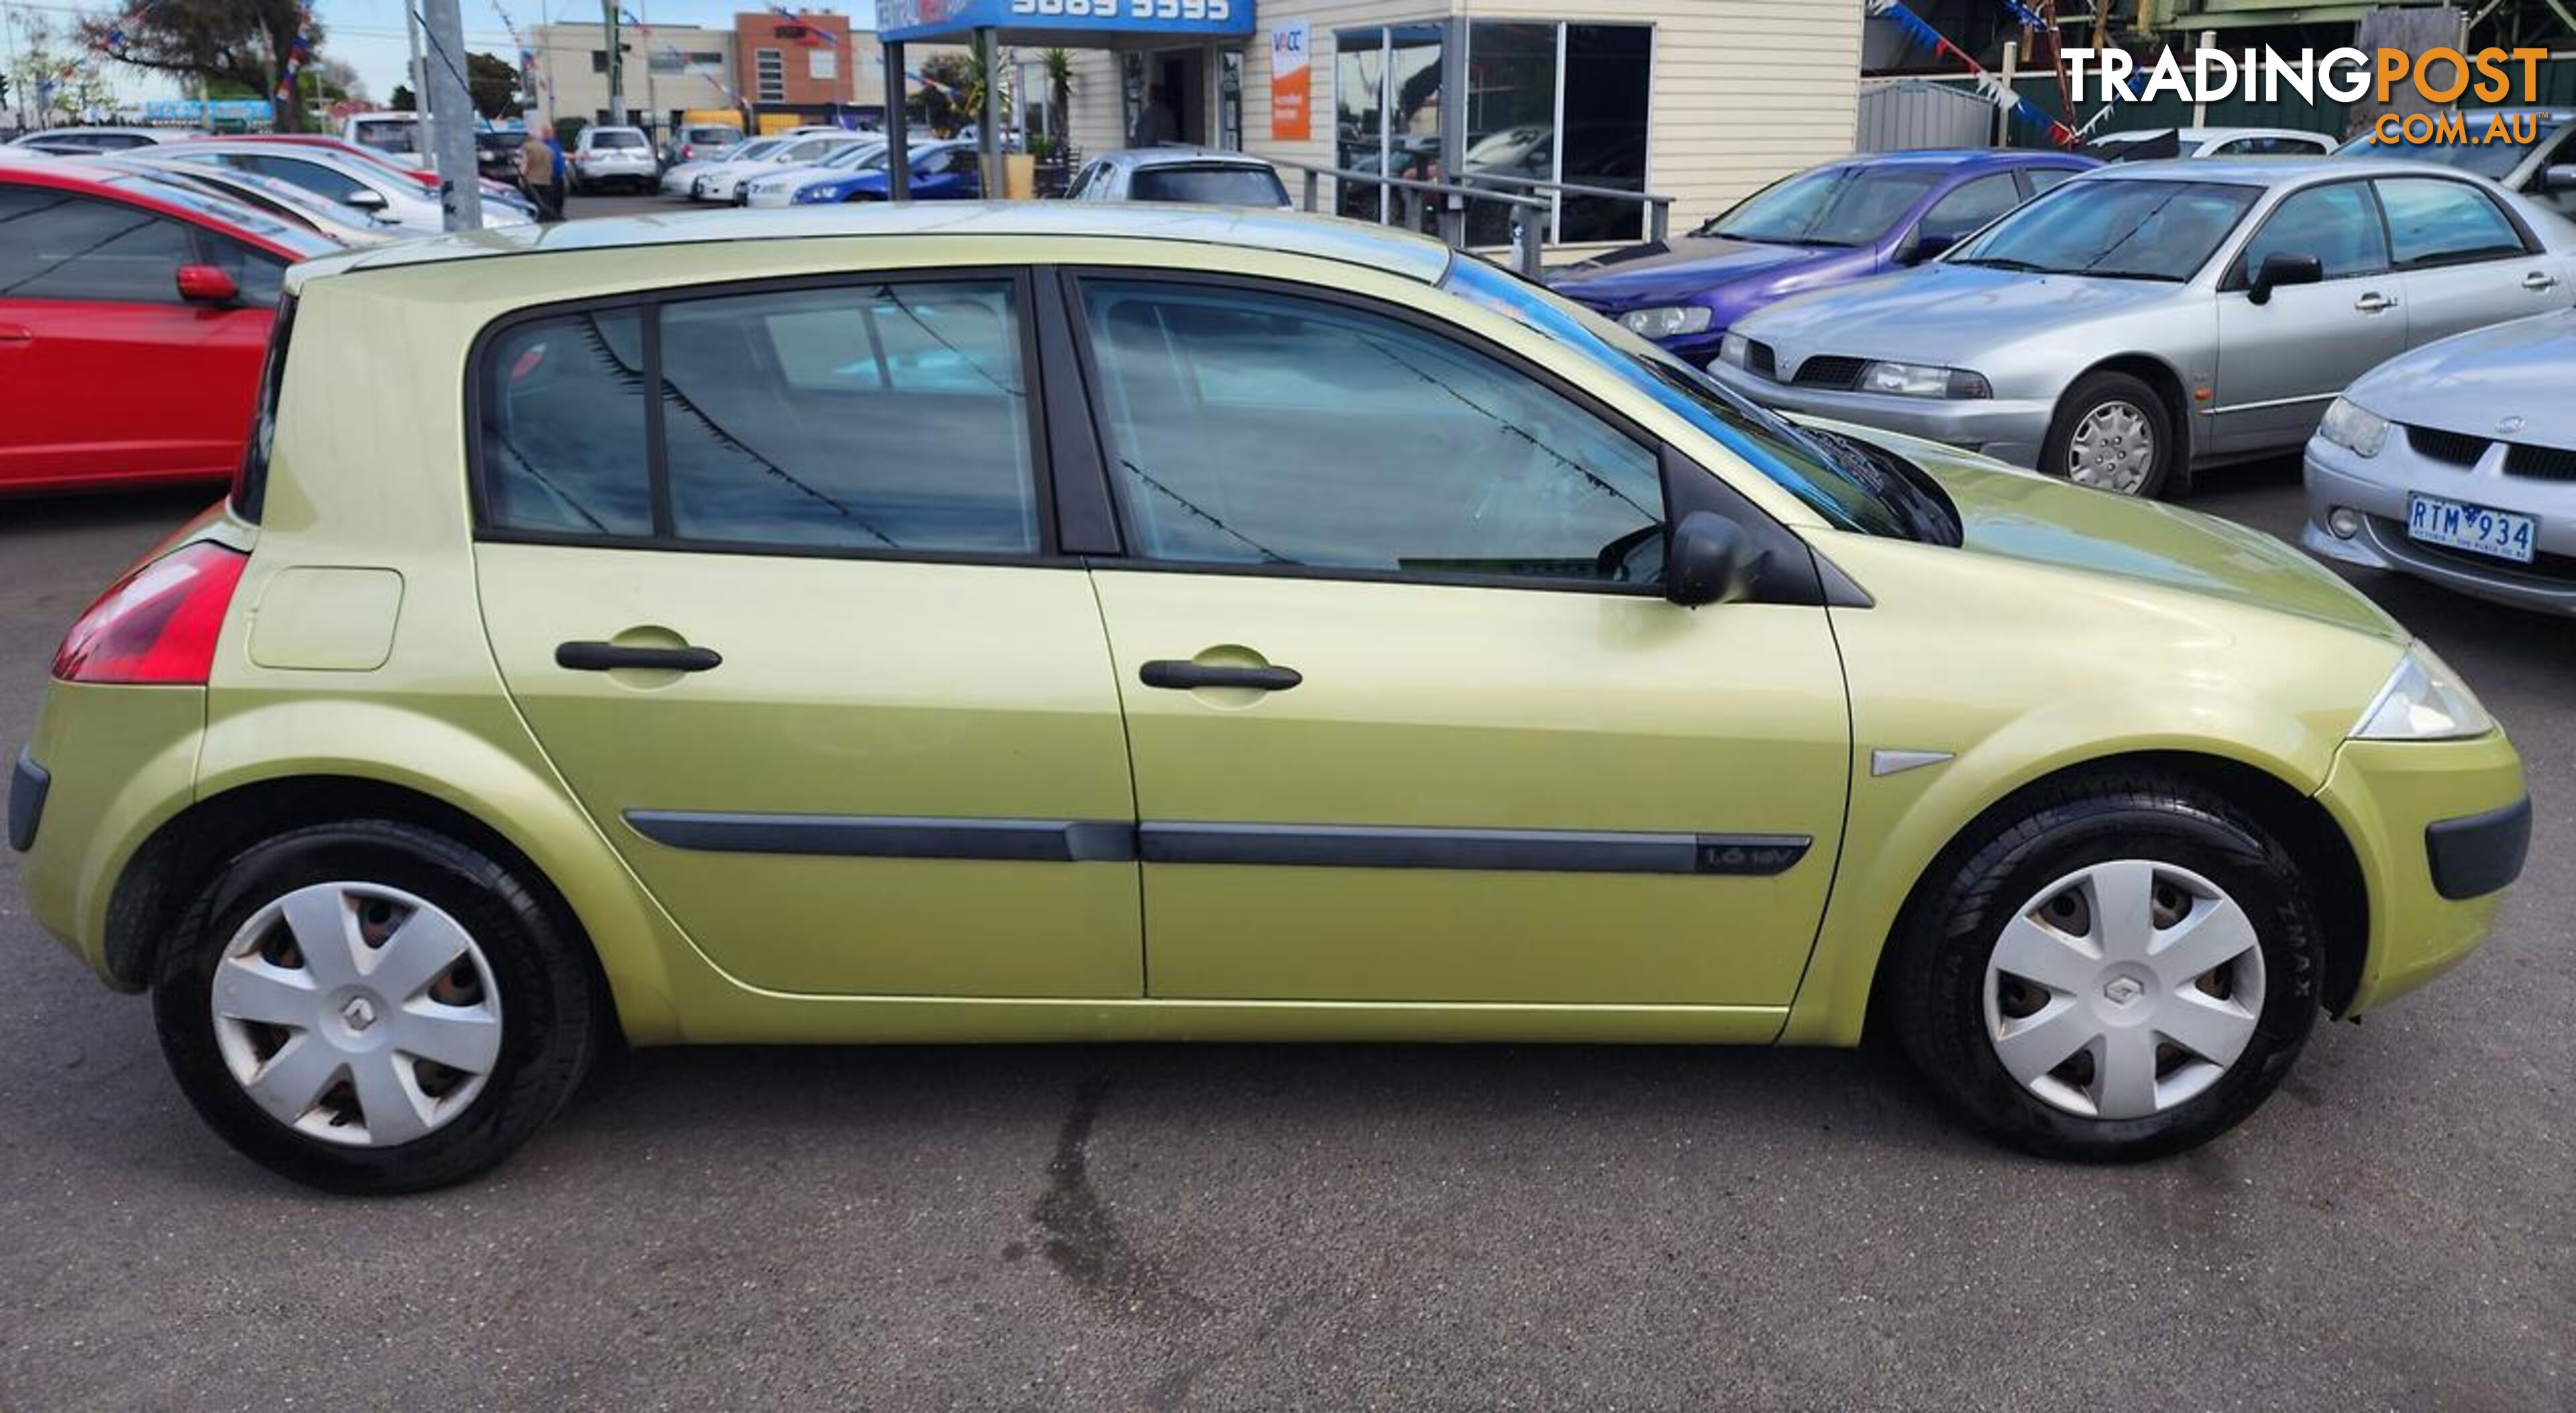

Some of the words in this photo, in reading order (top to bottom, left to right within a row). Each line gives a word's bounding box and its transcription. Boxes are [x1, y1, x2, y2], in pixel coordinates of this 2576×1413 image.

[1273, 31, 1302, 52] VACC
[2412, 501, 2460, 535] RTM
[2479, 514, 2529, 550] 934
[1707, 847, 1746, 865] 1.6
